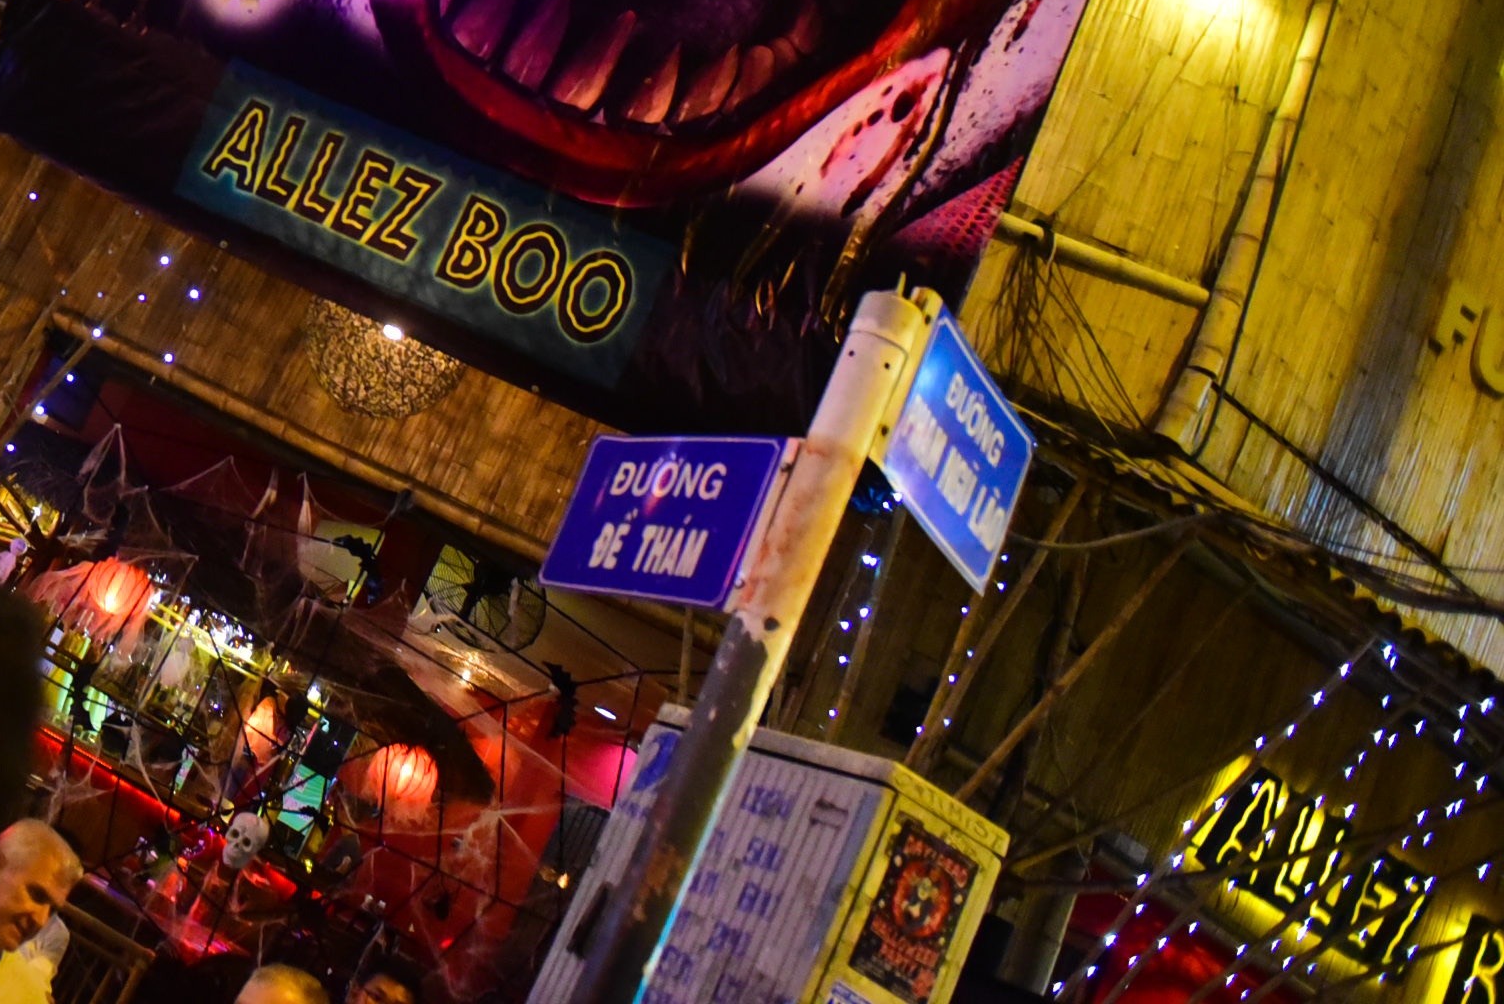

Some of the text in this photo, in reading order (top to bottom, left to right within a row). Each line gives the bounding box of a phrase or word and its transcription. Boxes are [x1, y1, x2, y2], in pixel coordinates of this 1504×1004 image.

[202, 98, 634, 345] ALLEZ BOO
[610, 452, 727, 500] ĐƯỜNG
[631, 513, 709, 579] THÁM
